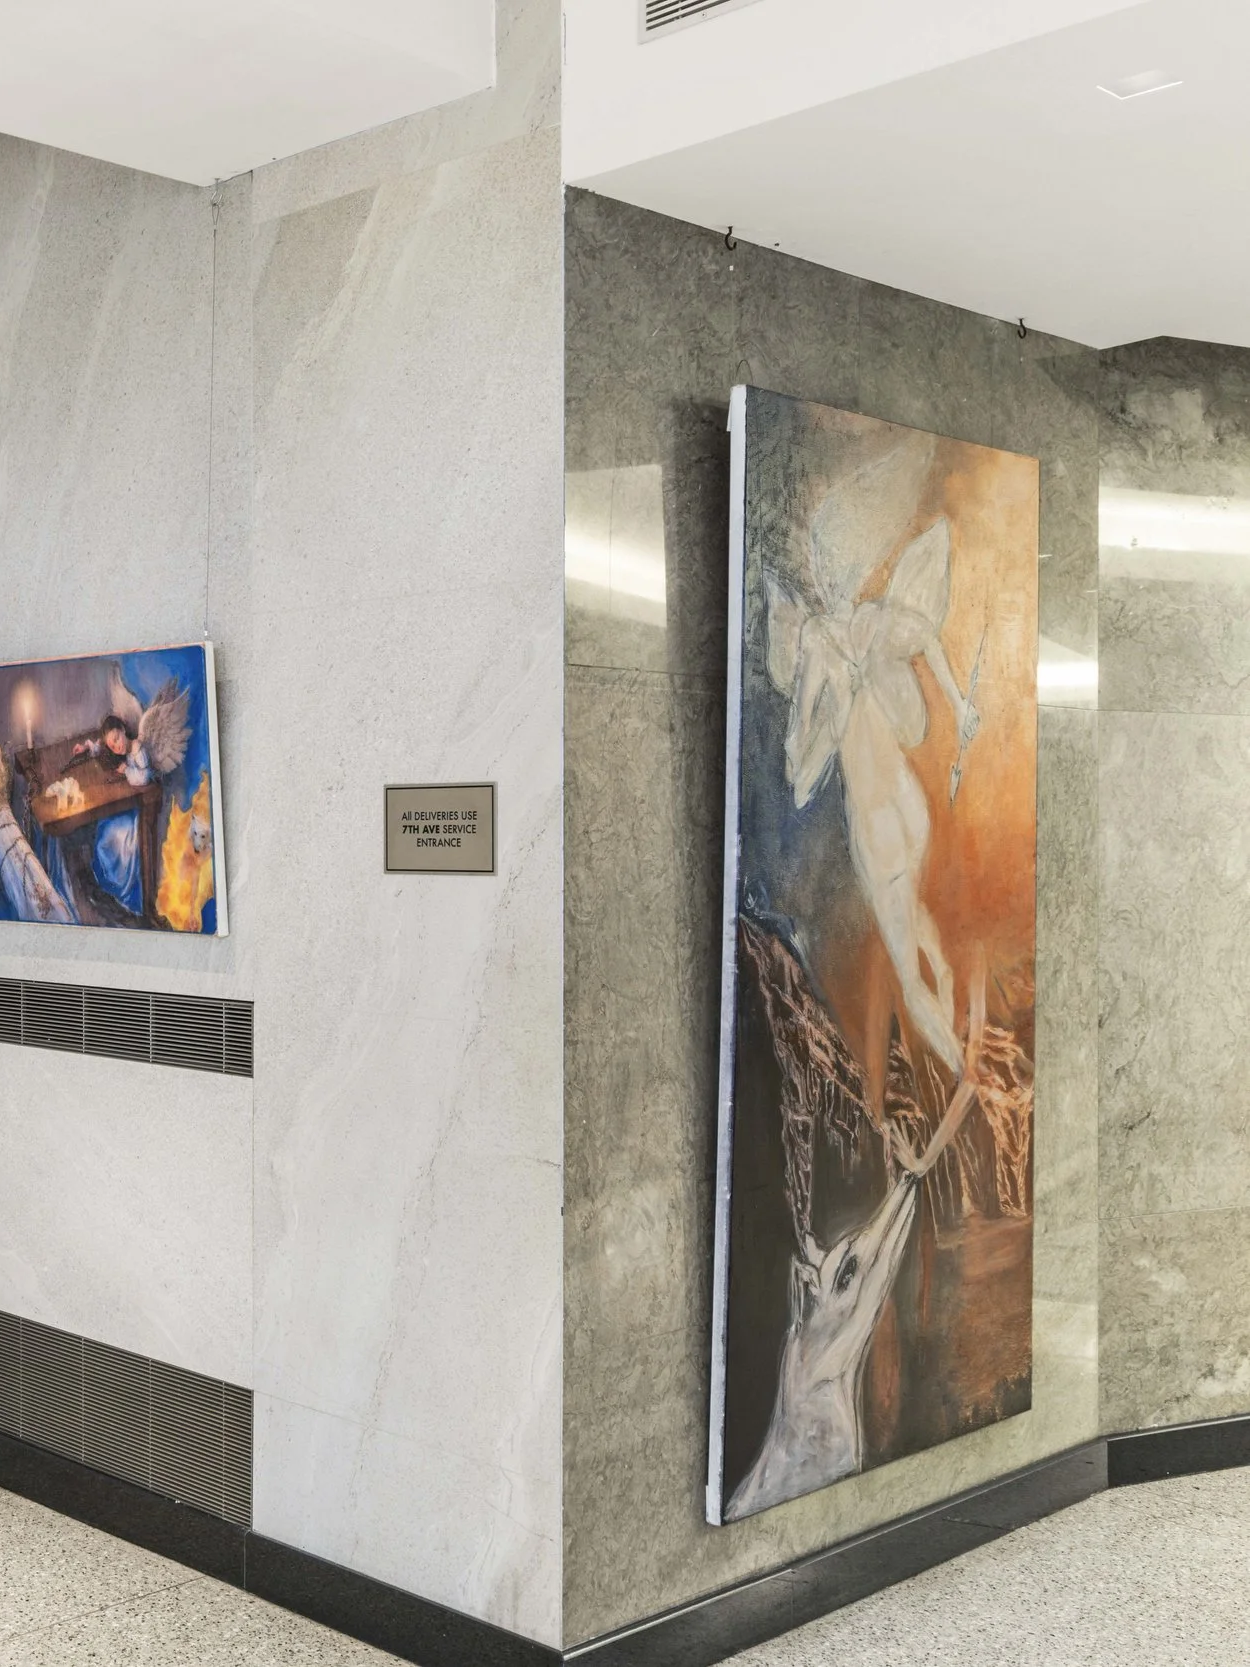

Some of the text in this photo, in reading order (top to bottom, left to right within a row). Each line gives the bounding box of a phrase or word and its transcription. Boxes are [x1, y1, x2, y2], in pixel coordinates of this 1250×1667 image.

[415, 811, 459, 820] DELIVERIES
[461, 810, 477, 820] USE
[402, 825, 477, 834] 7TH AVE SERVICE
[417, 838, 461, 848] ENTRANCE
